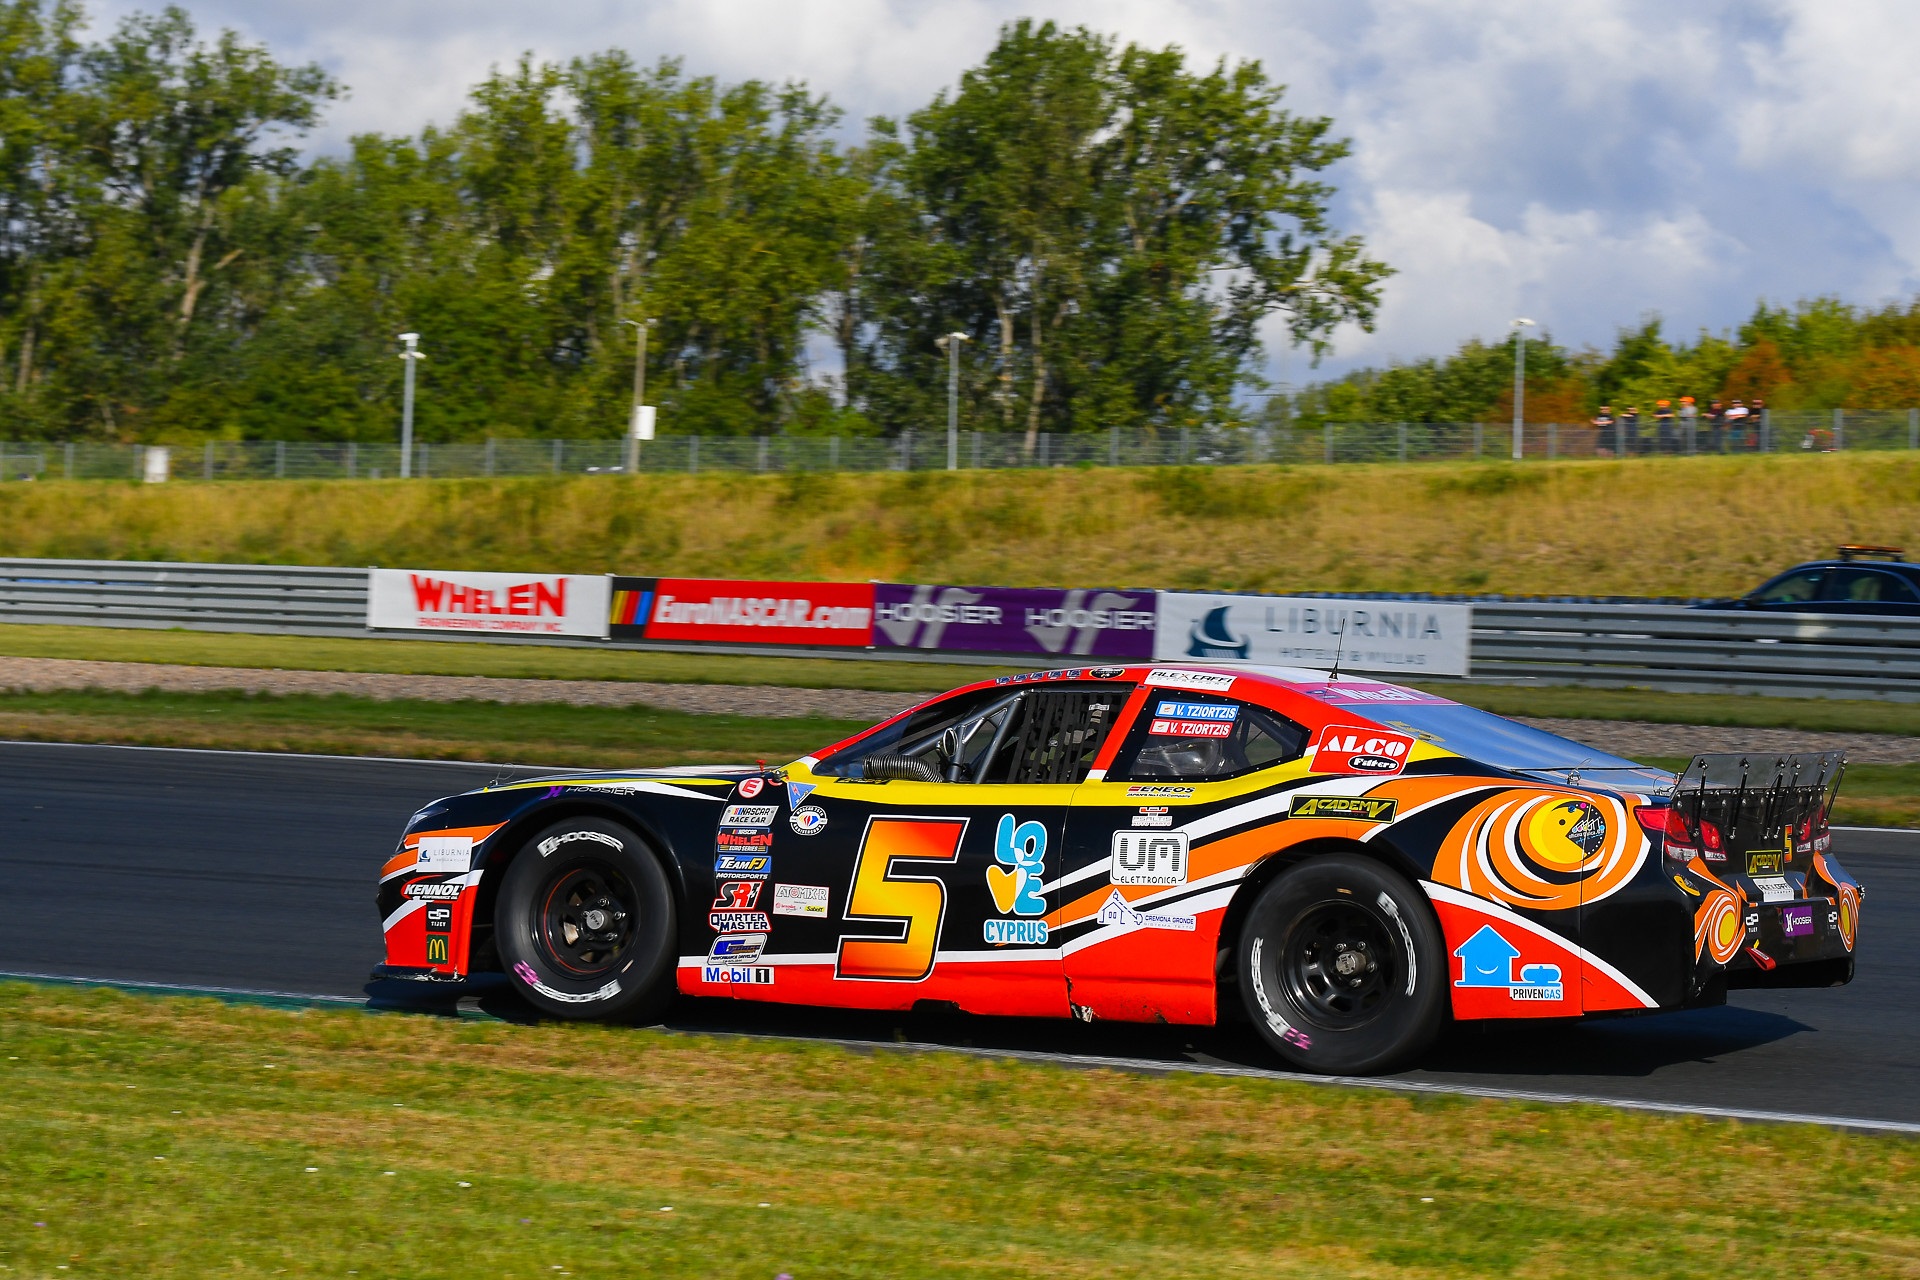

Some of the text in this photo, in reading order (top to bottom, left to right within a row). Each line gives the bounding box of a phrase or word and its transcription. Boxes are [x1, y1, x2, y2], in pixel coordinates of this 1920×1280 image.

[409, 573, 569, 617] WHELEN
[653, 595, 872, 629] EuroNASCAR.com
[875, 602, 1003, 625] HOOSIER
[1025, 607, 1156, 631] HOOSIER
[1264, 606, 1443, 640] LIBURNIA
[1152, 671, 1234, 683] ALEX CAFFI
[1176, 705, 1237, 719] V. TZIORTZIS
[1169, 722, 1231, 736] V. TZIORTZIS
[1322, 735, 1406, 757] ALCO
[565, 786, 636, 796] HOOSIER
[741, 807, 770, 816] NASCAR
[1293, 798, 1393, 818] ACADEMY
[717, 833, 773, 846] WHELEN
[1784, 824, 1792, 863] 5
[1119, 837, 1181, 872] UM
[1749, 855, 1780, 873] ACADEMY
[715, 872, 769, 880] MOTORSPORTS
[1120, 876, 1177, 884] ELETTRONICA
[404, 884, 461, 896] KENNOL
[833, 814, 971, 983] 5
[711, 914, 765, 926] QUARTER
[720, 921, 768, 931] MASTER
[984, 920, 1048, 944] CYPRUS
[706, 967, 750, 982] Mobil
[1512, 988, 1561, 999] PRIVENGAS
